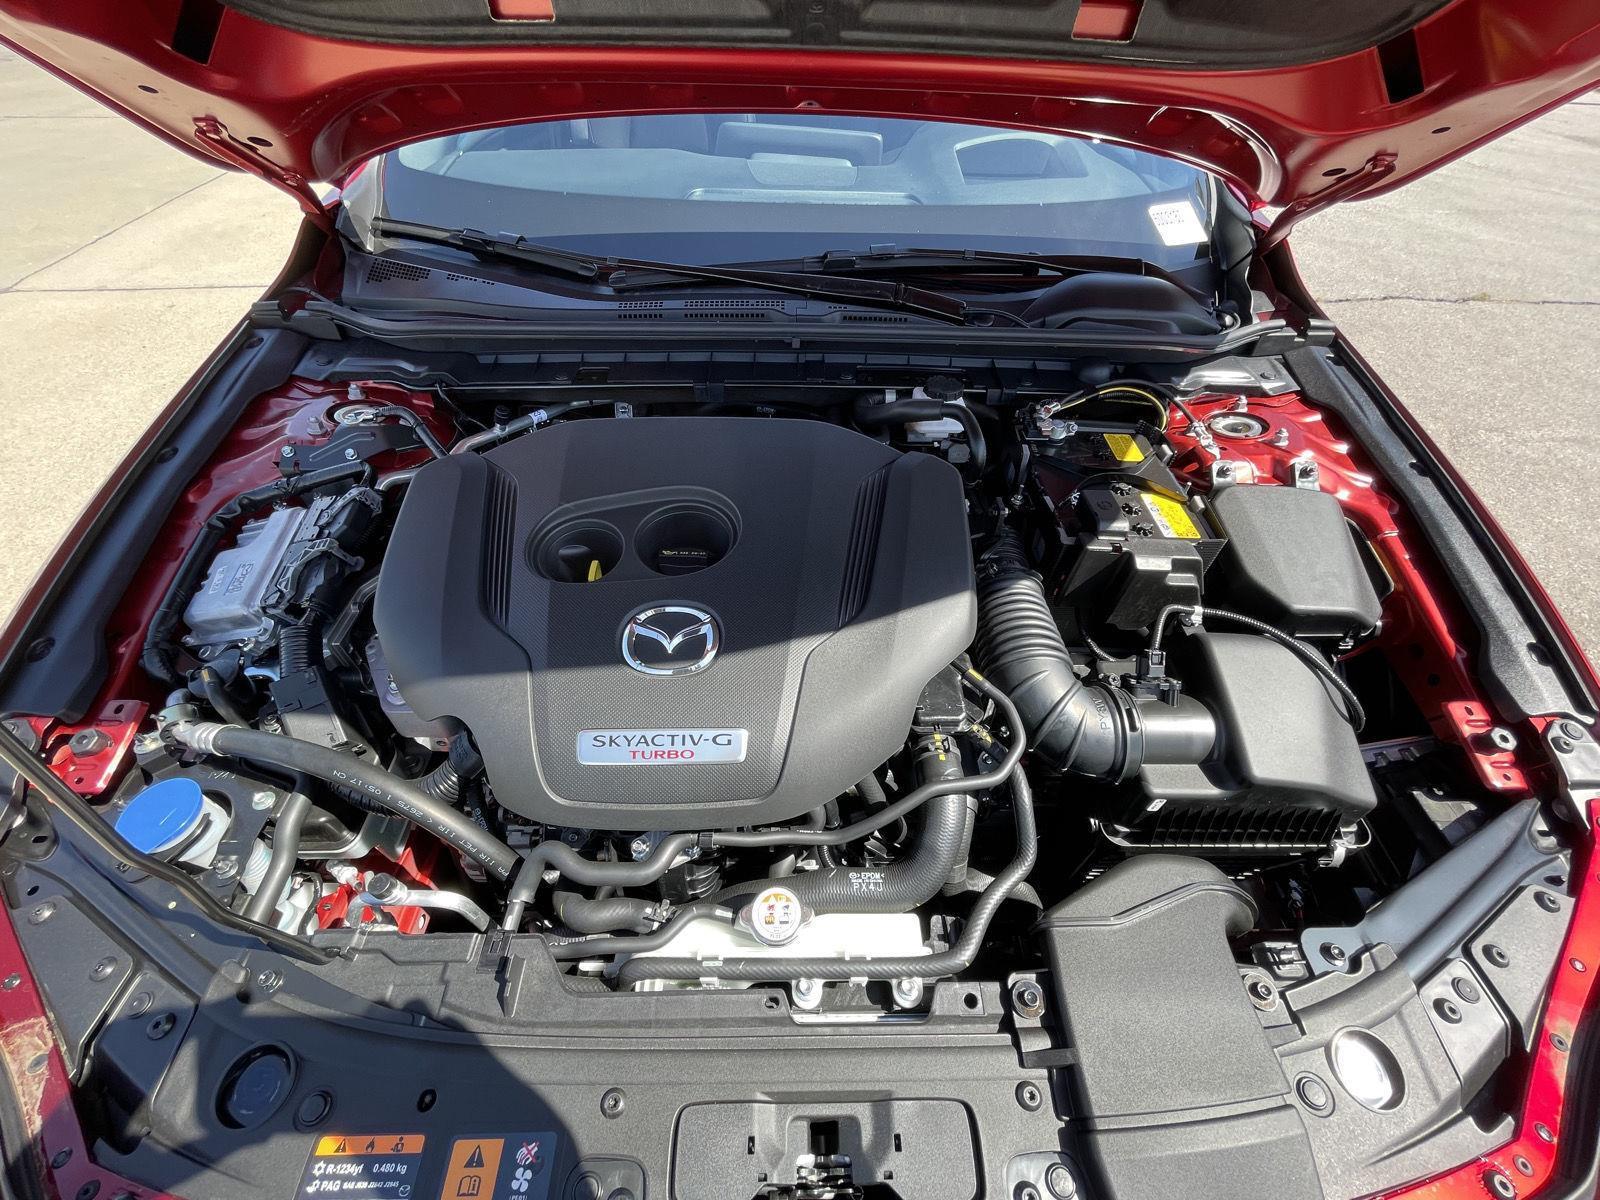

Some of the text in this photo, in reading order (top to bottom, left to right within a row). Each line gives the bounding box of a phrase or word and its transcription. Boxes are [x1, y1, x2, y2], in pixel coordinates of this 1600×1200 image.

[592, 733, 732, 747] SKYACTIV-G
[629, 749, 695, 760] TURBO
[332, 770, 347, 779] CN
[458, 839, 478, 853] PET
[372, 1163, 395, 1173] 0.480
[396, 1163, 408, 1175] kg
[320, 1180, 341, 1192] PAG
